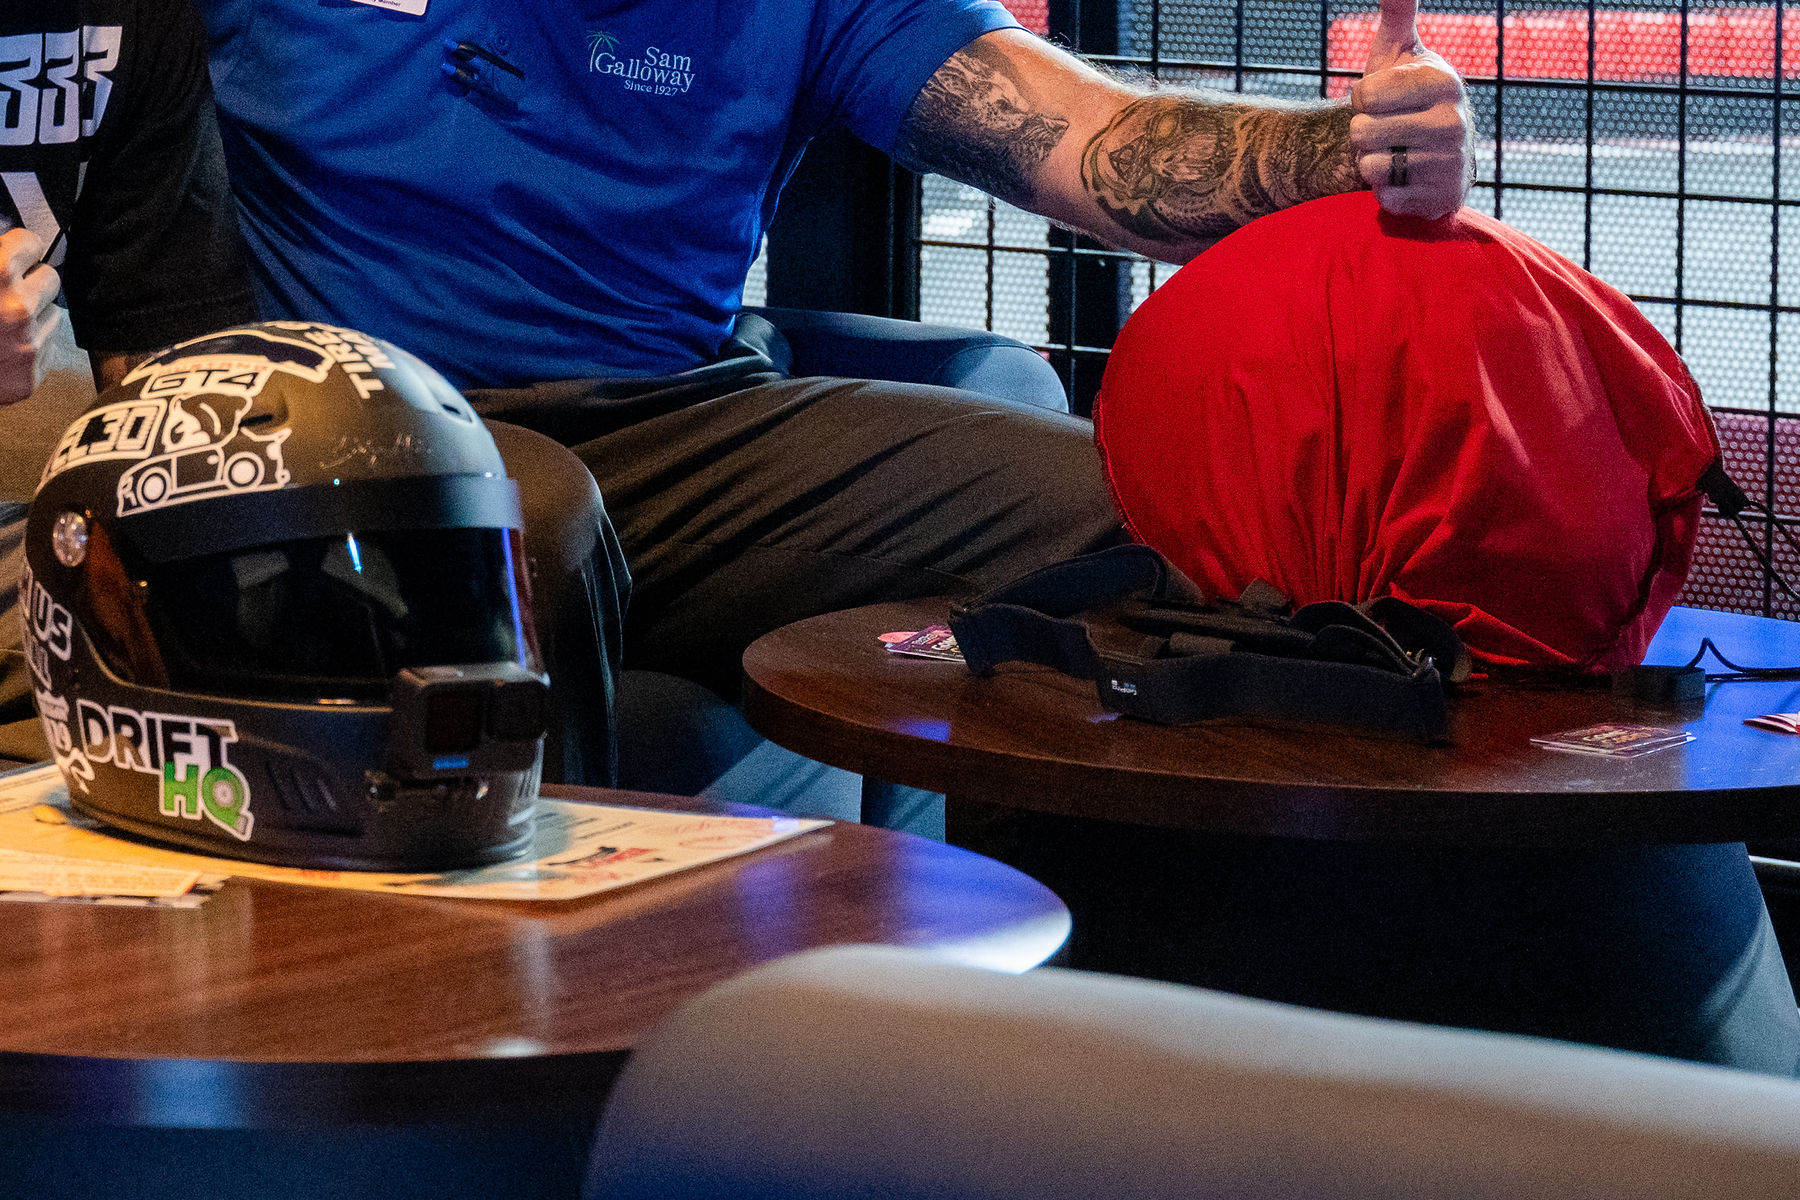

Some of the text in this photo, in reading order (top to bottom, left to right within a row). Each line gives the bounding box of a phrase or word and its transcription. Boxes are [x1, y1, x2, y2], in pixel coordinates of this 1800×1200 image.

[595, 52, 696, 93] Galloway
[644, 46, 691, 72] Sam
[623, 80, 678, 97] Since 1927
[147, 368, 260, 393] GT4
[77, 699, 239, 774] DRIFT
[159, 761, 255, 842] HQ
